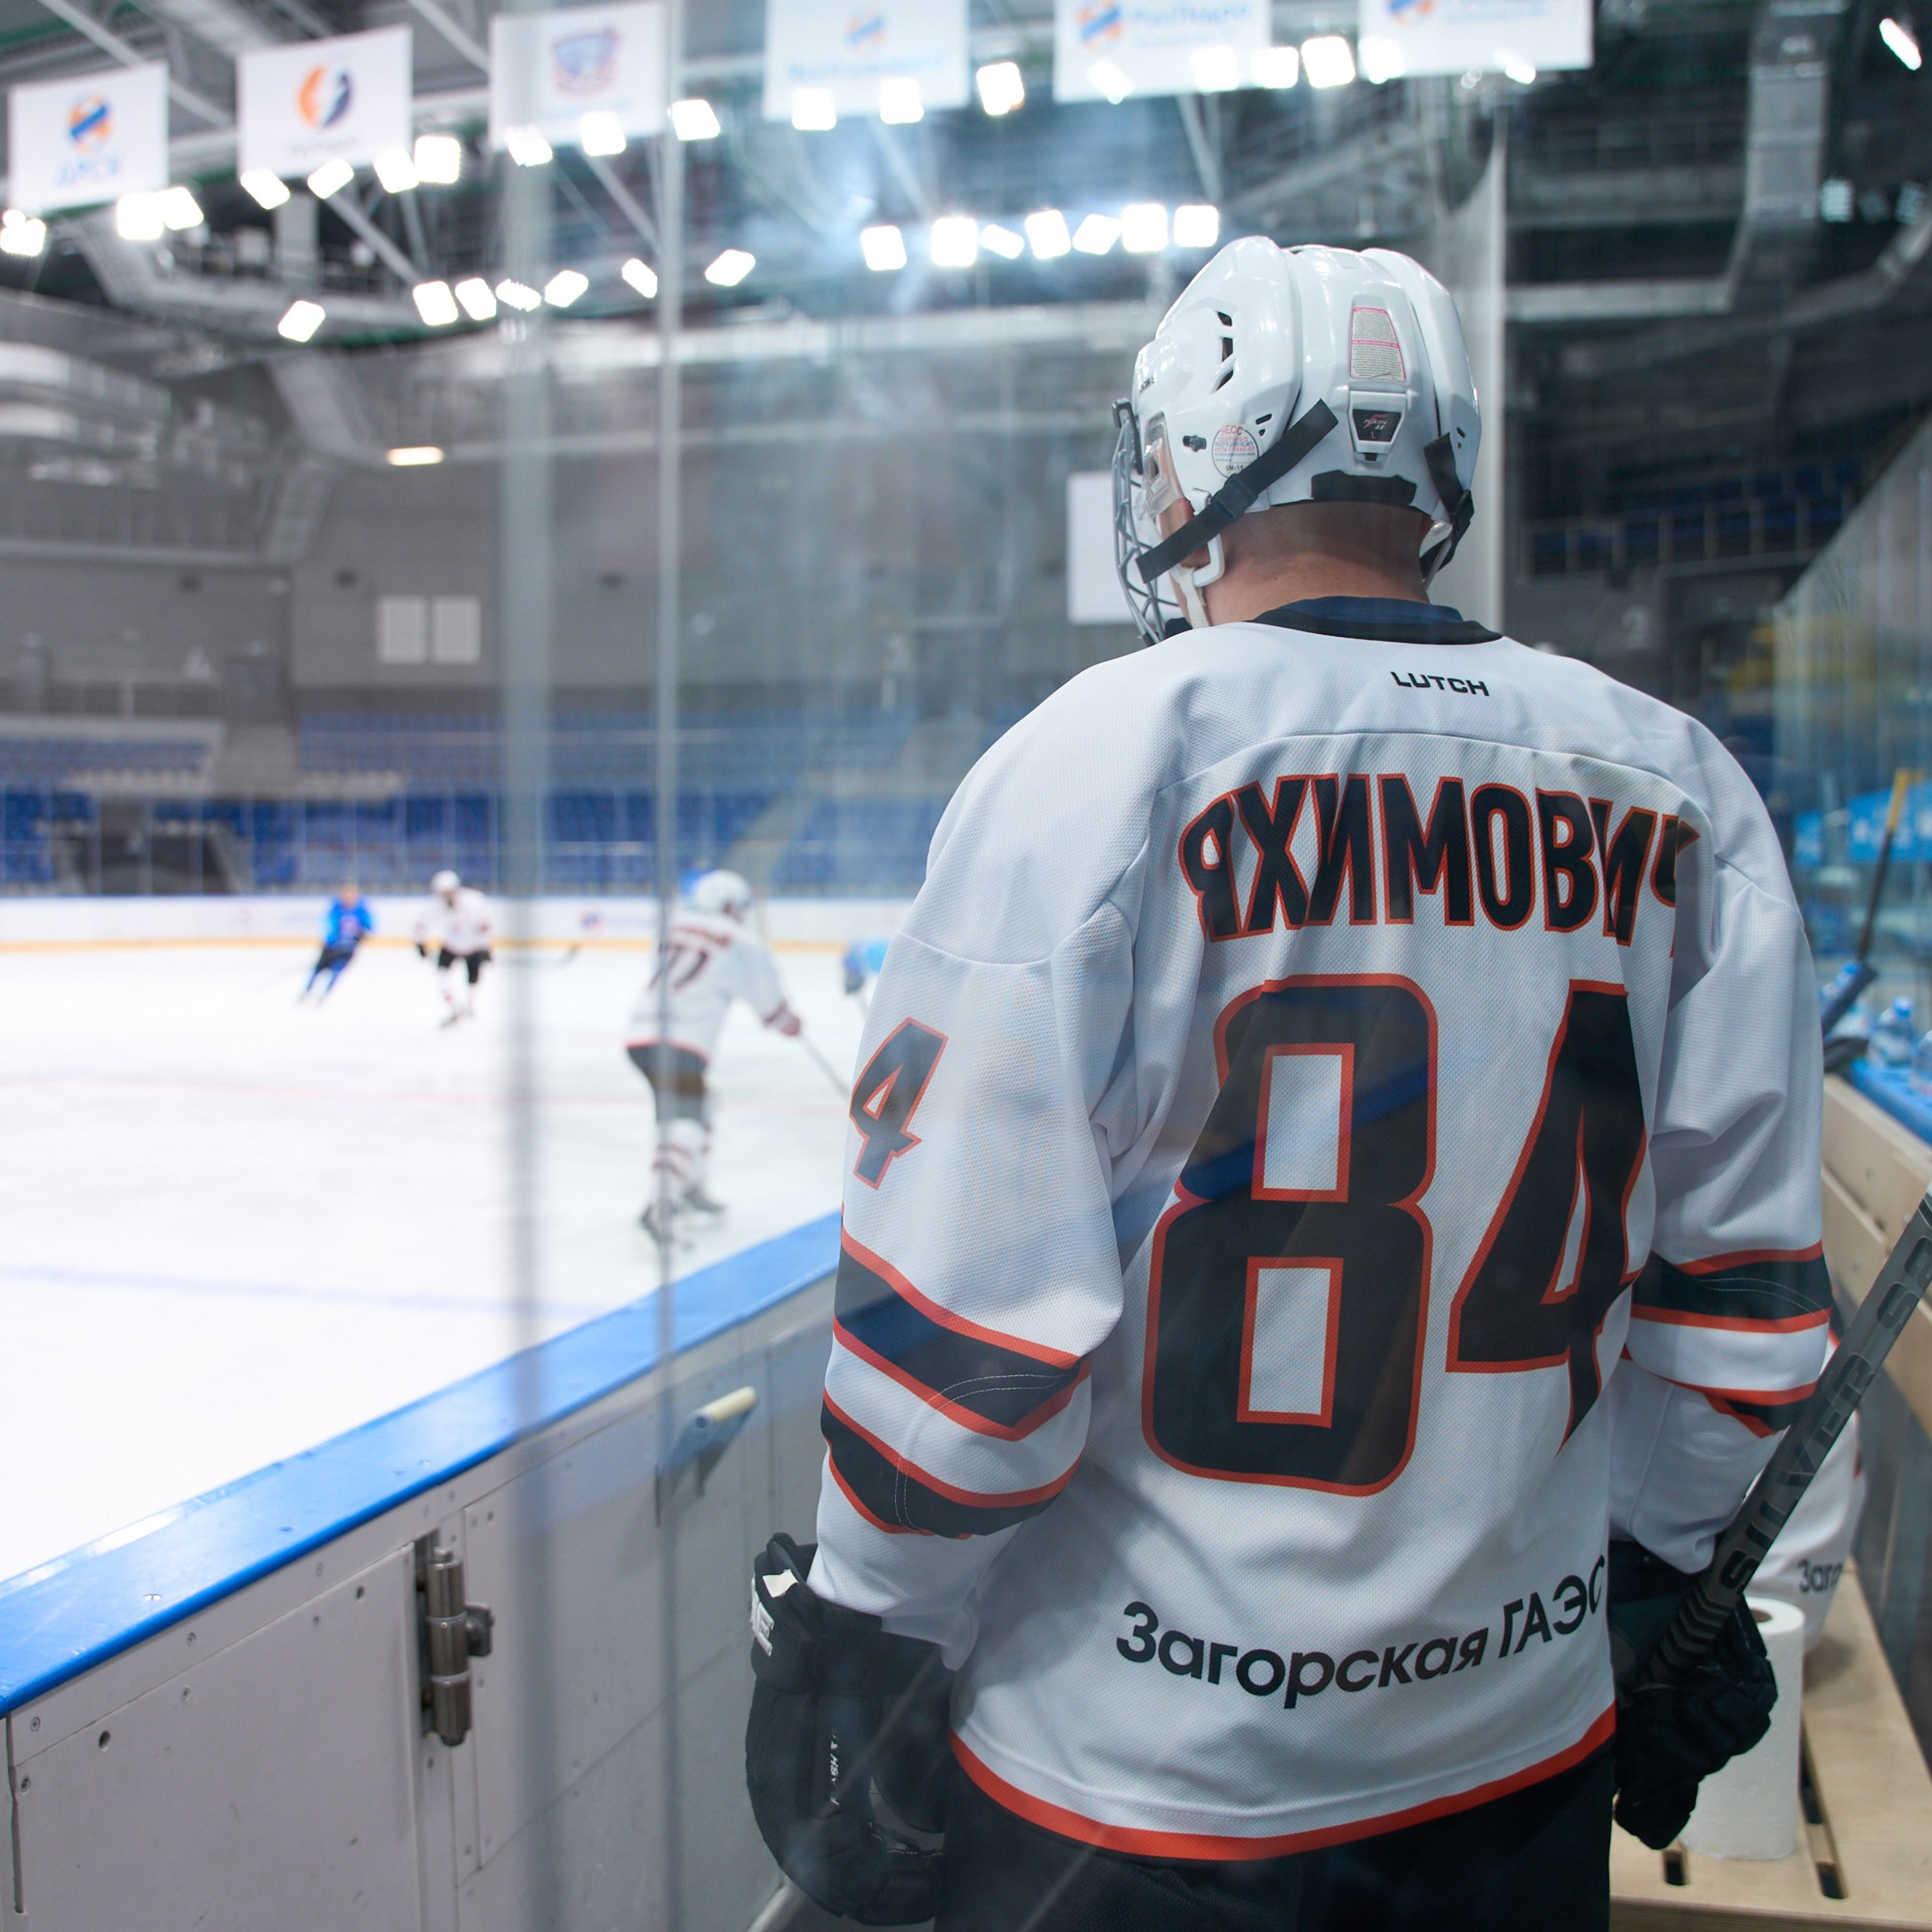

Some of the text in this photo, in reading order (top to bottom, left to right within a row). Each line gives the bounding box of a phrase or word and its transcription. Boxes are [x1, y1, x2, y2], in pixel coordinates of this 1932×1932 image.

[1390, 671, 1489, 696] LUTCH
[1141, 973, 1647, 1497] 84
[1116, 1555, 1605, 1709] Загорская ГАЭС
